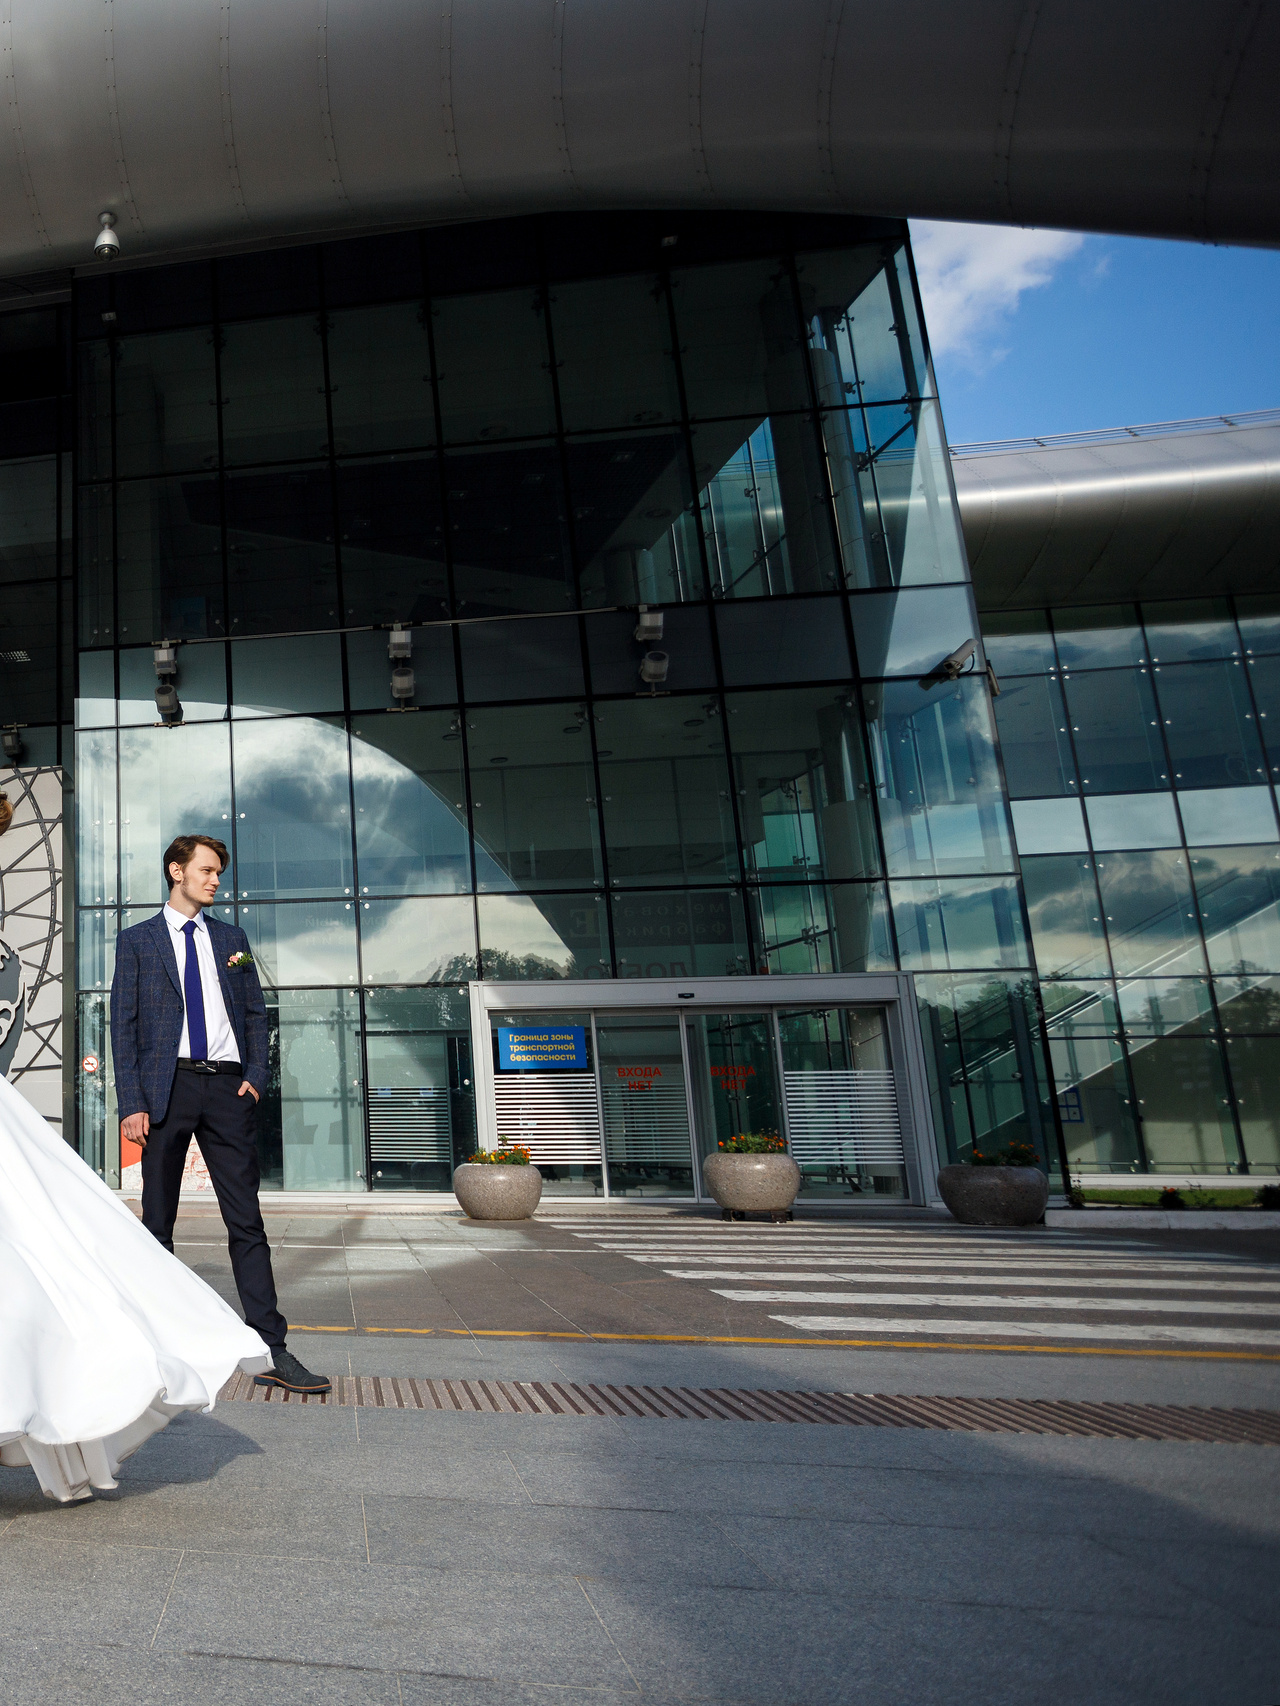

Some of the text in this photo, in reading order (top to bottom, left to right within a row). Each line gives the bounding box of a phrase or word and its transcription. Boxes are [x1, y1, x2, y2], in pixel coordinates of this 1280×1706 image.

[509, 1034, 549, 1043] Граница
[509, 1043, 575, 1052] транспортной
[510, 1053, 576, 1062] безопасности
[617, 1067, 662, 1078] ВХОДА
[710, 1066, 756, 1077] ВХОДА
[628, 1080, 653, 1091] НЕТ
[721, 1080, 747, 1090] НЕТ
